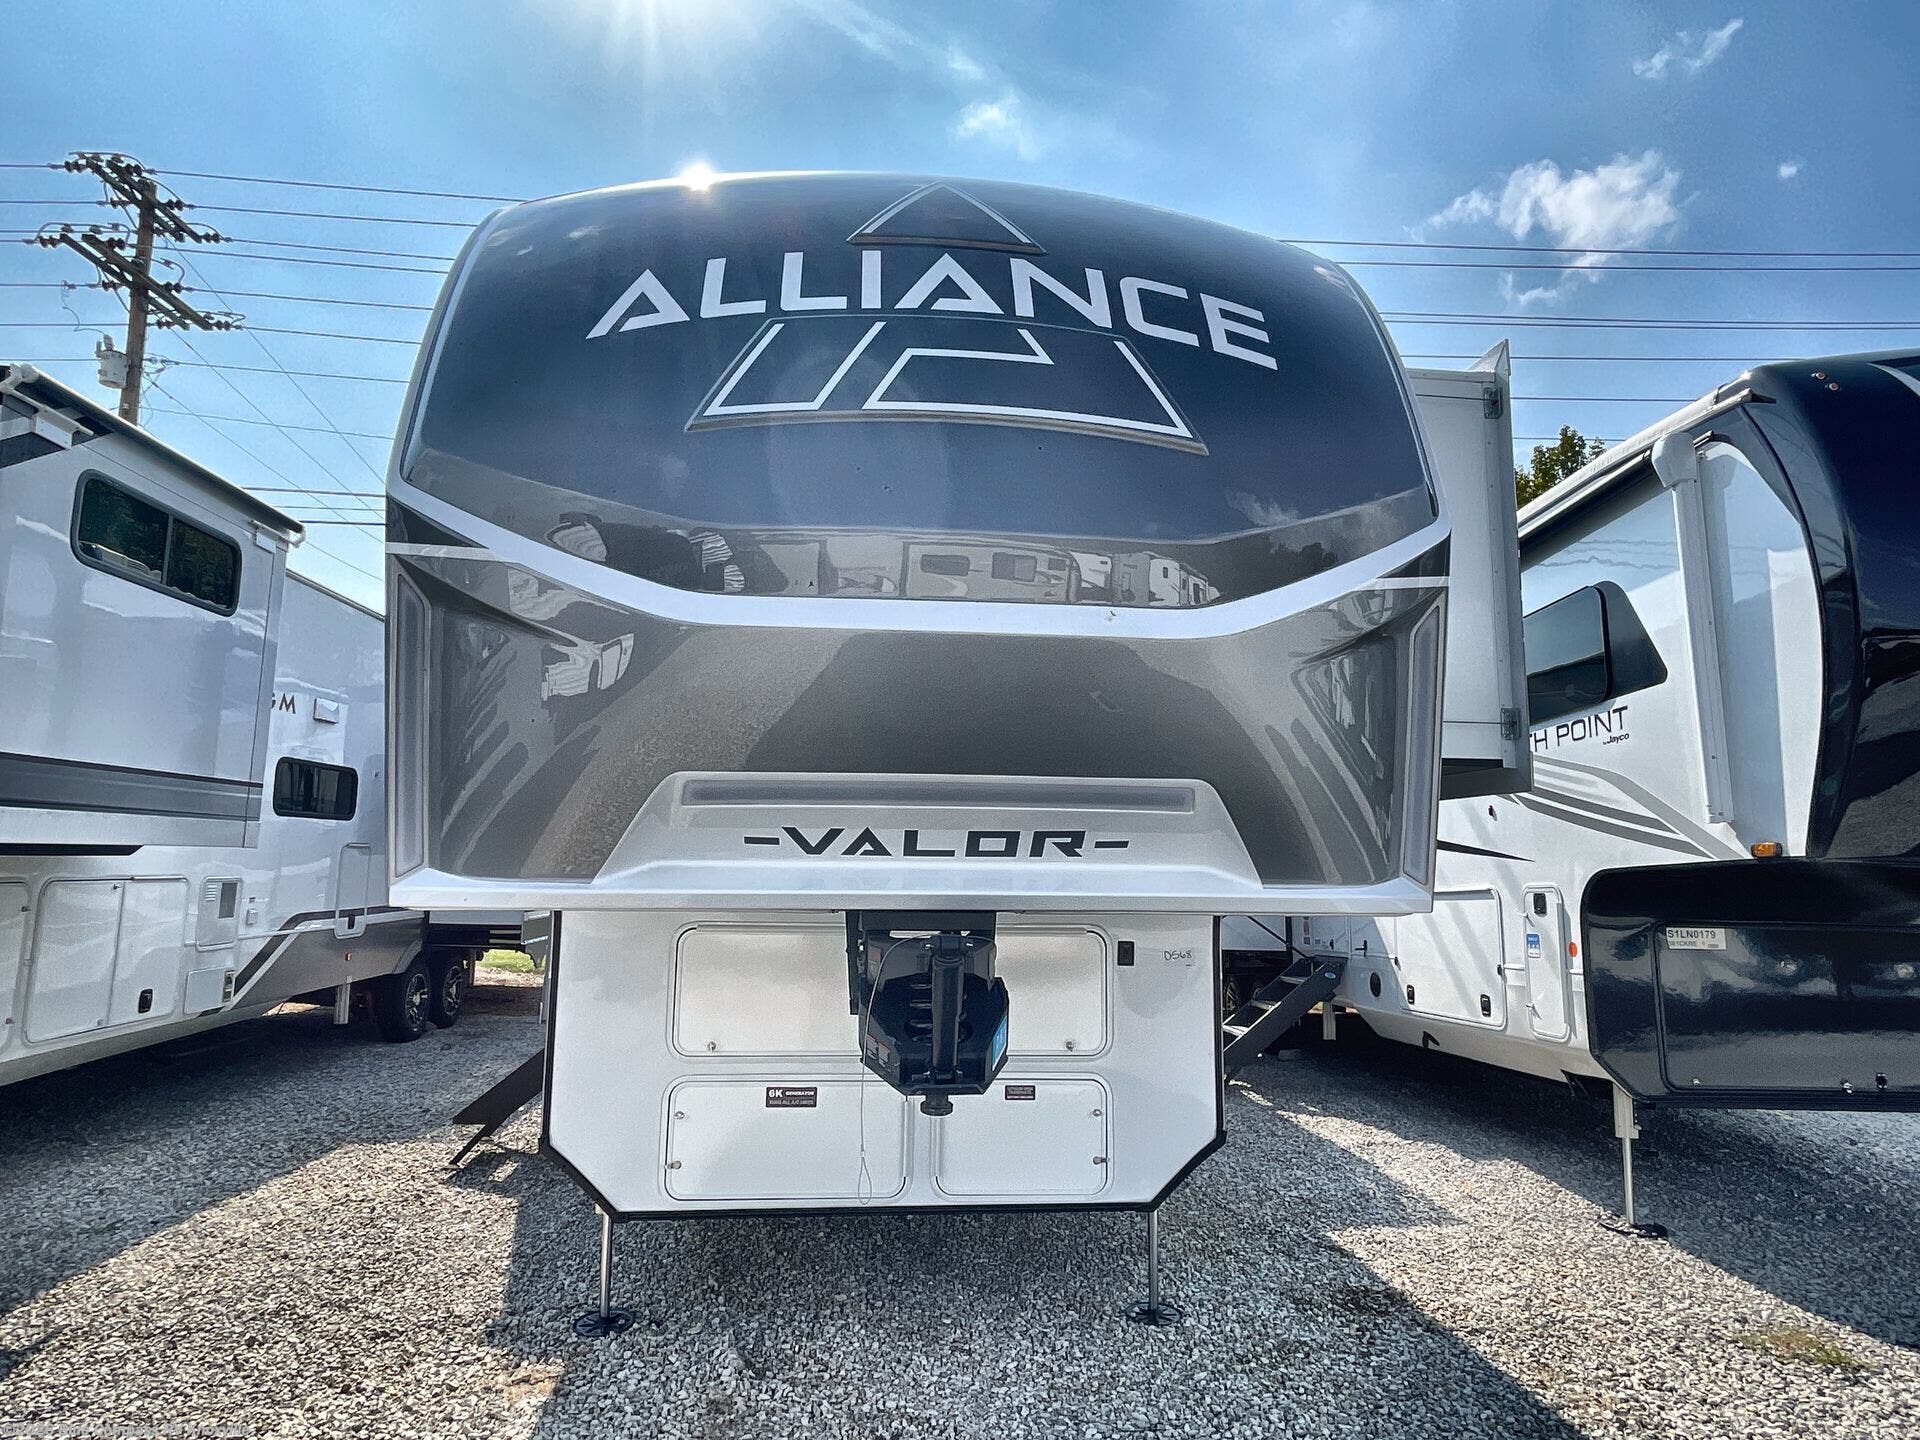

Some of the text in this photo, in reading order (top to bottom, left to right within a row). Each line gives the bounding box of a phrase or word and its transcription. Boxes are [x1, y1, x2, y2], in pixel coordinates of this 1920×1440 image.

[586, 250, 1278, 371] ALLIANCE
[1556, 705, 1628, 746] POINT
[1667, 929, 1716, 939] S1LN0179
